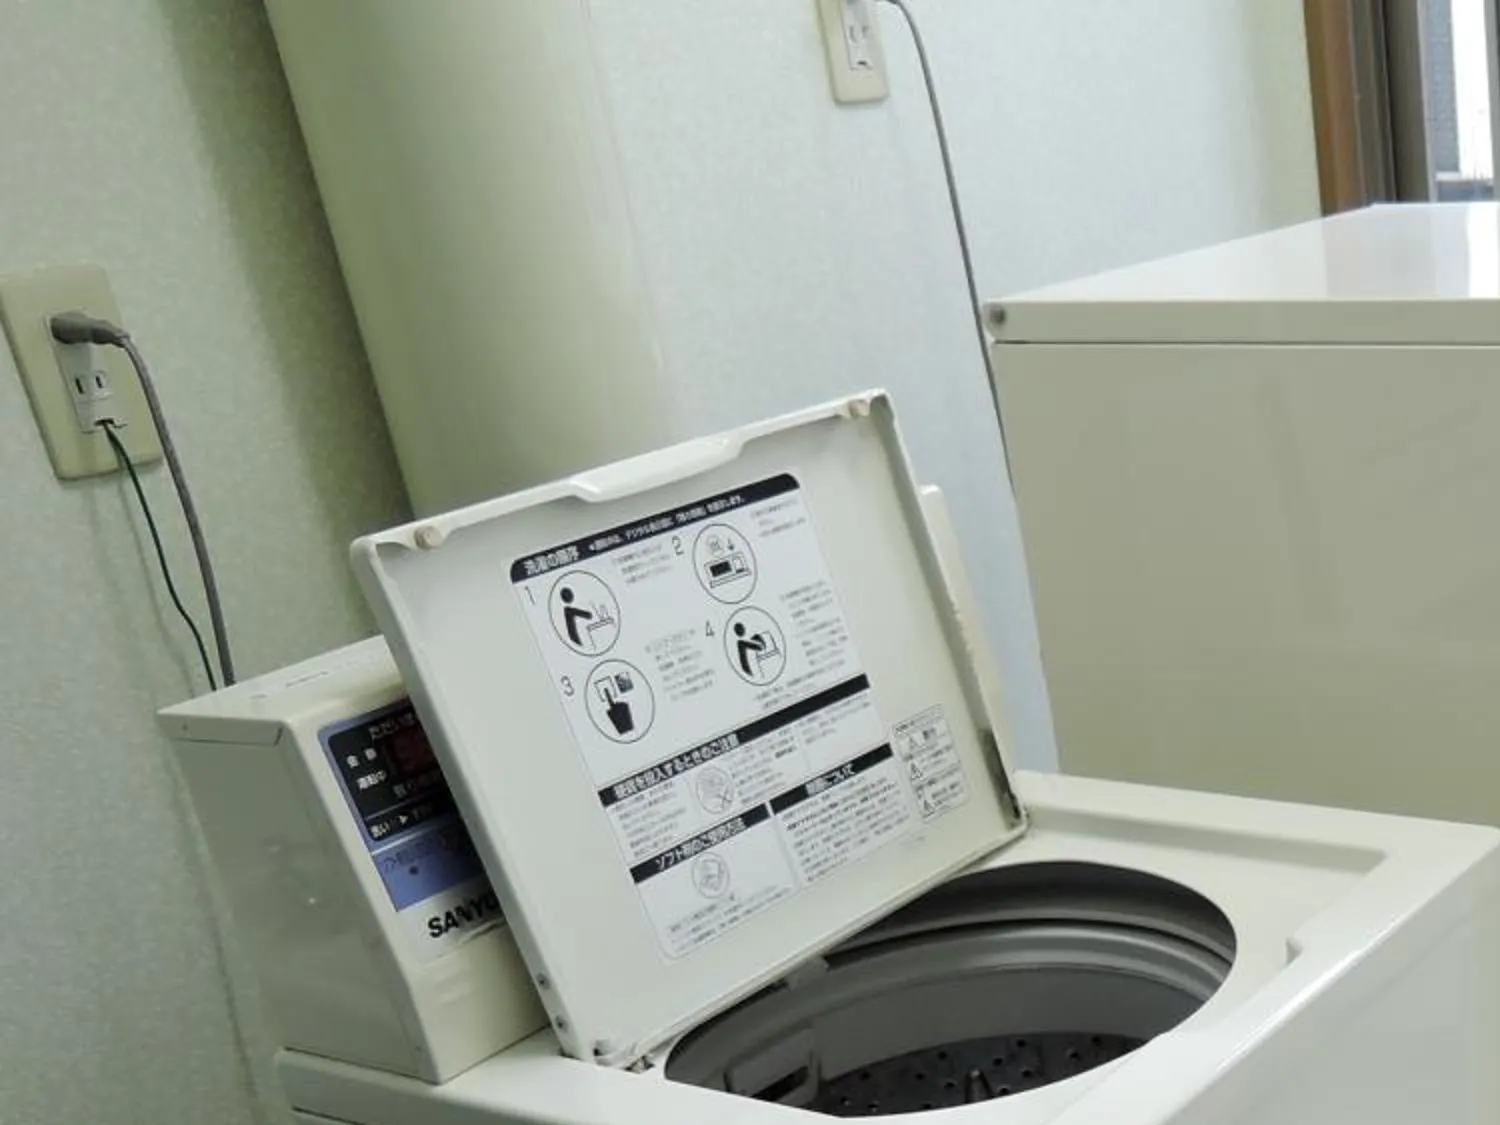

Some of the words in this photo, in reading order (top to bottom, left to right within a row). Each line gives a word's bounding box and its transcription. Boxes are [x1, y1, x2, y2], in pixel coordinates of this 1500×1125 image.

[671, 535, 685, 557] 2
[704, 620, 715, 637] 4
[559, 675, 575, 697] 3
